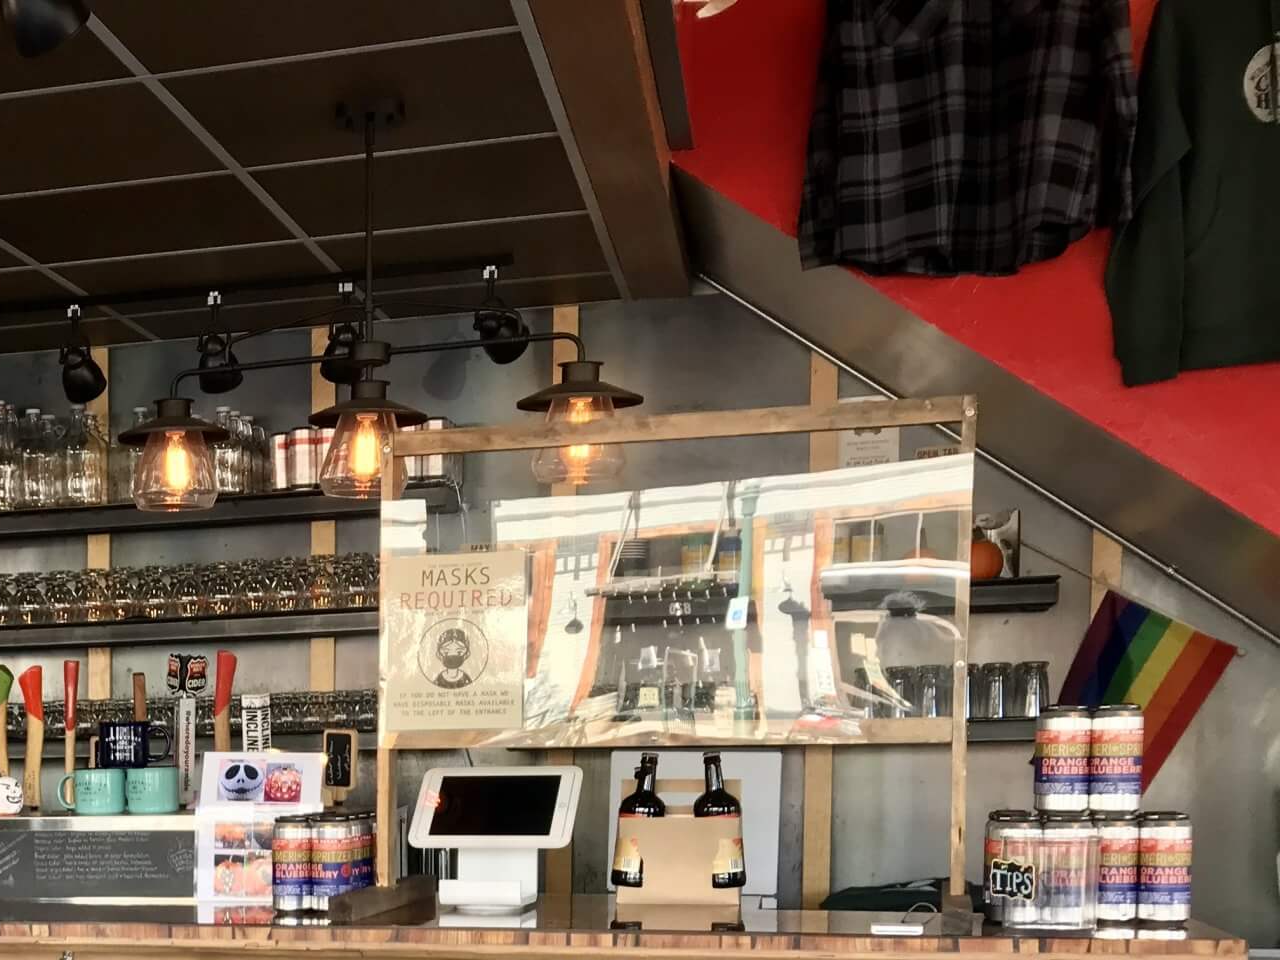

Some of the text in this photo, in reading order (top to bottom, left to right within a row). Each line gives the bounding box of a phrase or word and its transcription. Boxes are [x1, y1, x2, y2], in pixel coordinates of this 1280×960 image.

[421, 567, 490, 587] MASKS
[400, 589, 512, 611] REQUIRED
[993, 868, 1033, 894] TIPS
